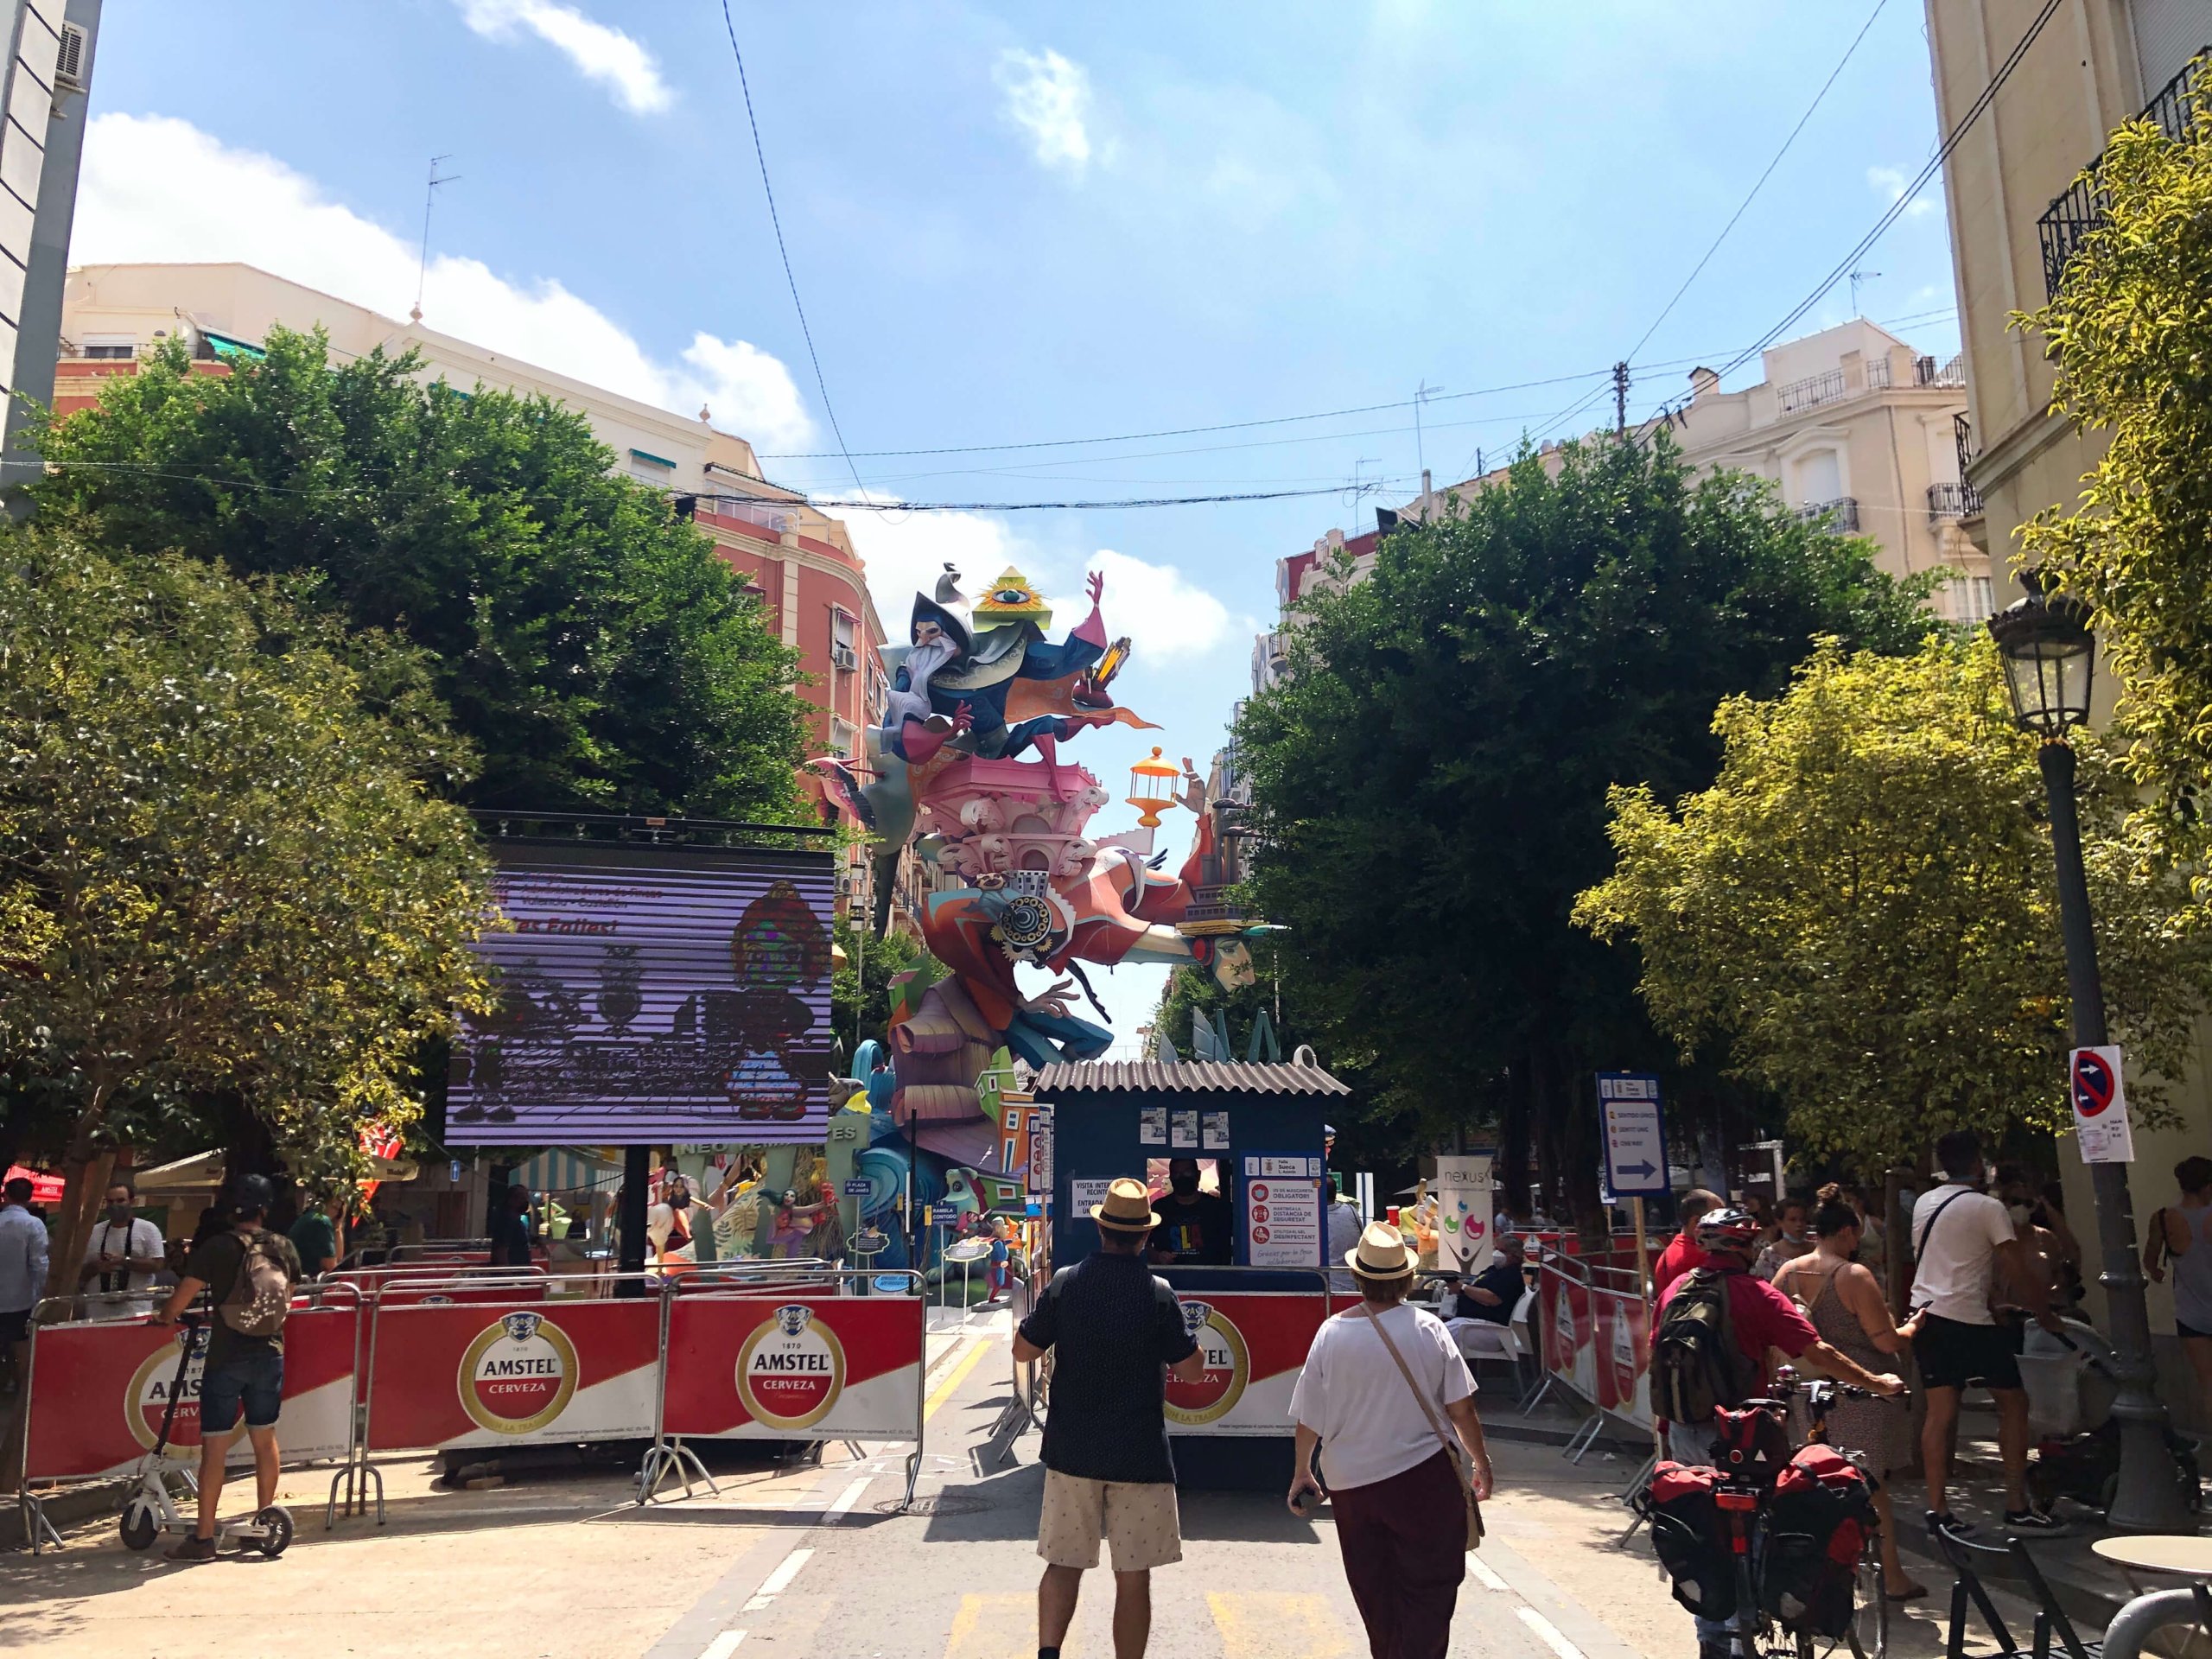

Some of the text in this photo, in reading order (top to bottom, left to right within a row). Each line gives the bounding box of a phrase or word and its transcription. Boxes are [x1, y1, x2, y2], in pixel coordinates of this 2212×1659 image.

[1445, 1171, 1484, 1183] nexus
[483, 1357, 556, 1376] AMSTEL
[754, 1354, 829, 1371] AMSTEL
[1166, 1374, 1219, 1383] CEZA
[149, 1378, 202, 1400] AMS
[488, 1382, 546, 1394] CERVEZA
[763, 1380, 816, 1390] CERVEZA
[160, 1408, 200, 1419] CERV
